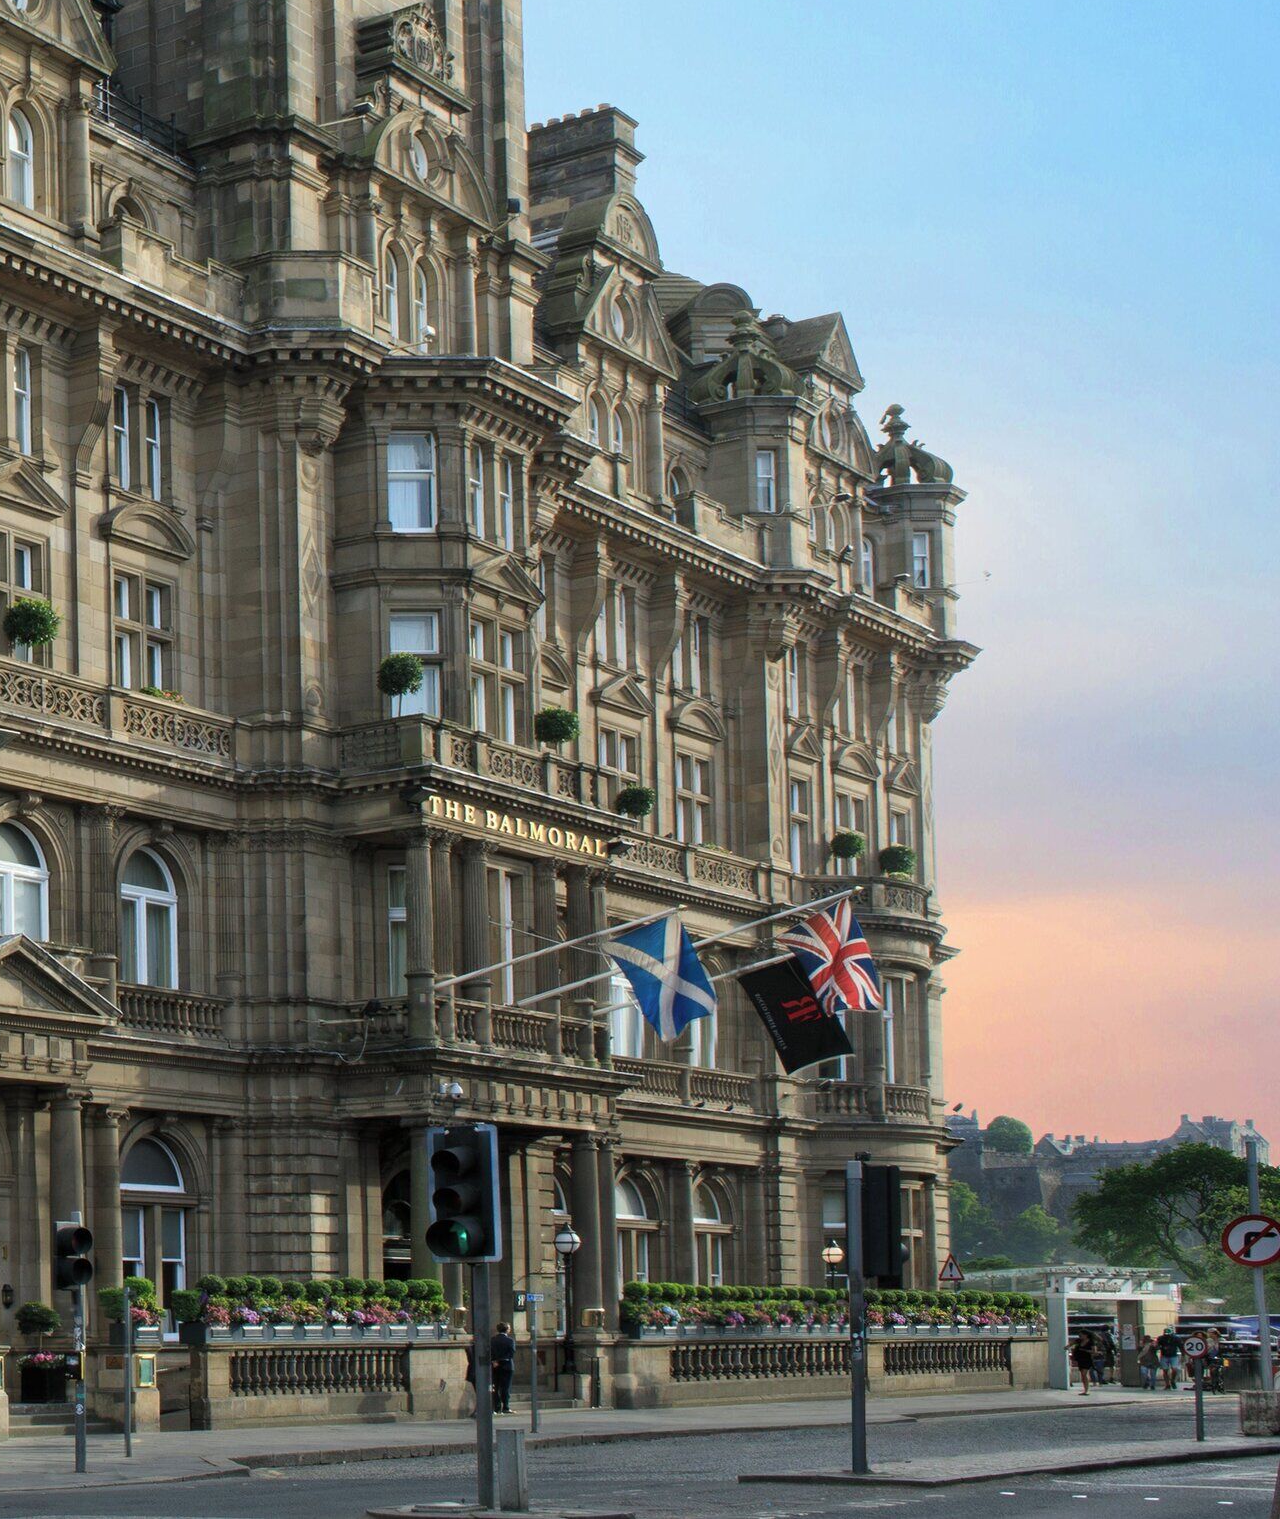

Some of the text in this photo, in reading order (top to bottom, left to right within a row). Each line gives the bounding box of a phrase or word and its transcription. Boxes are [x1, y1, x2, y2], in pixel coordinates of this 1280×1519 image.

[429, 795, 607, 858] THE BALMORAL
[1186, 1342, 1204, 1352] 20
